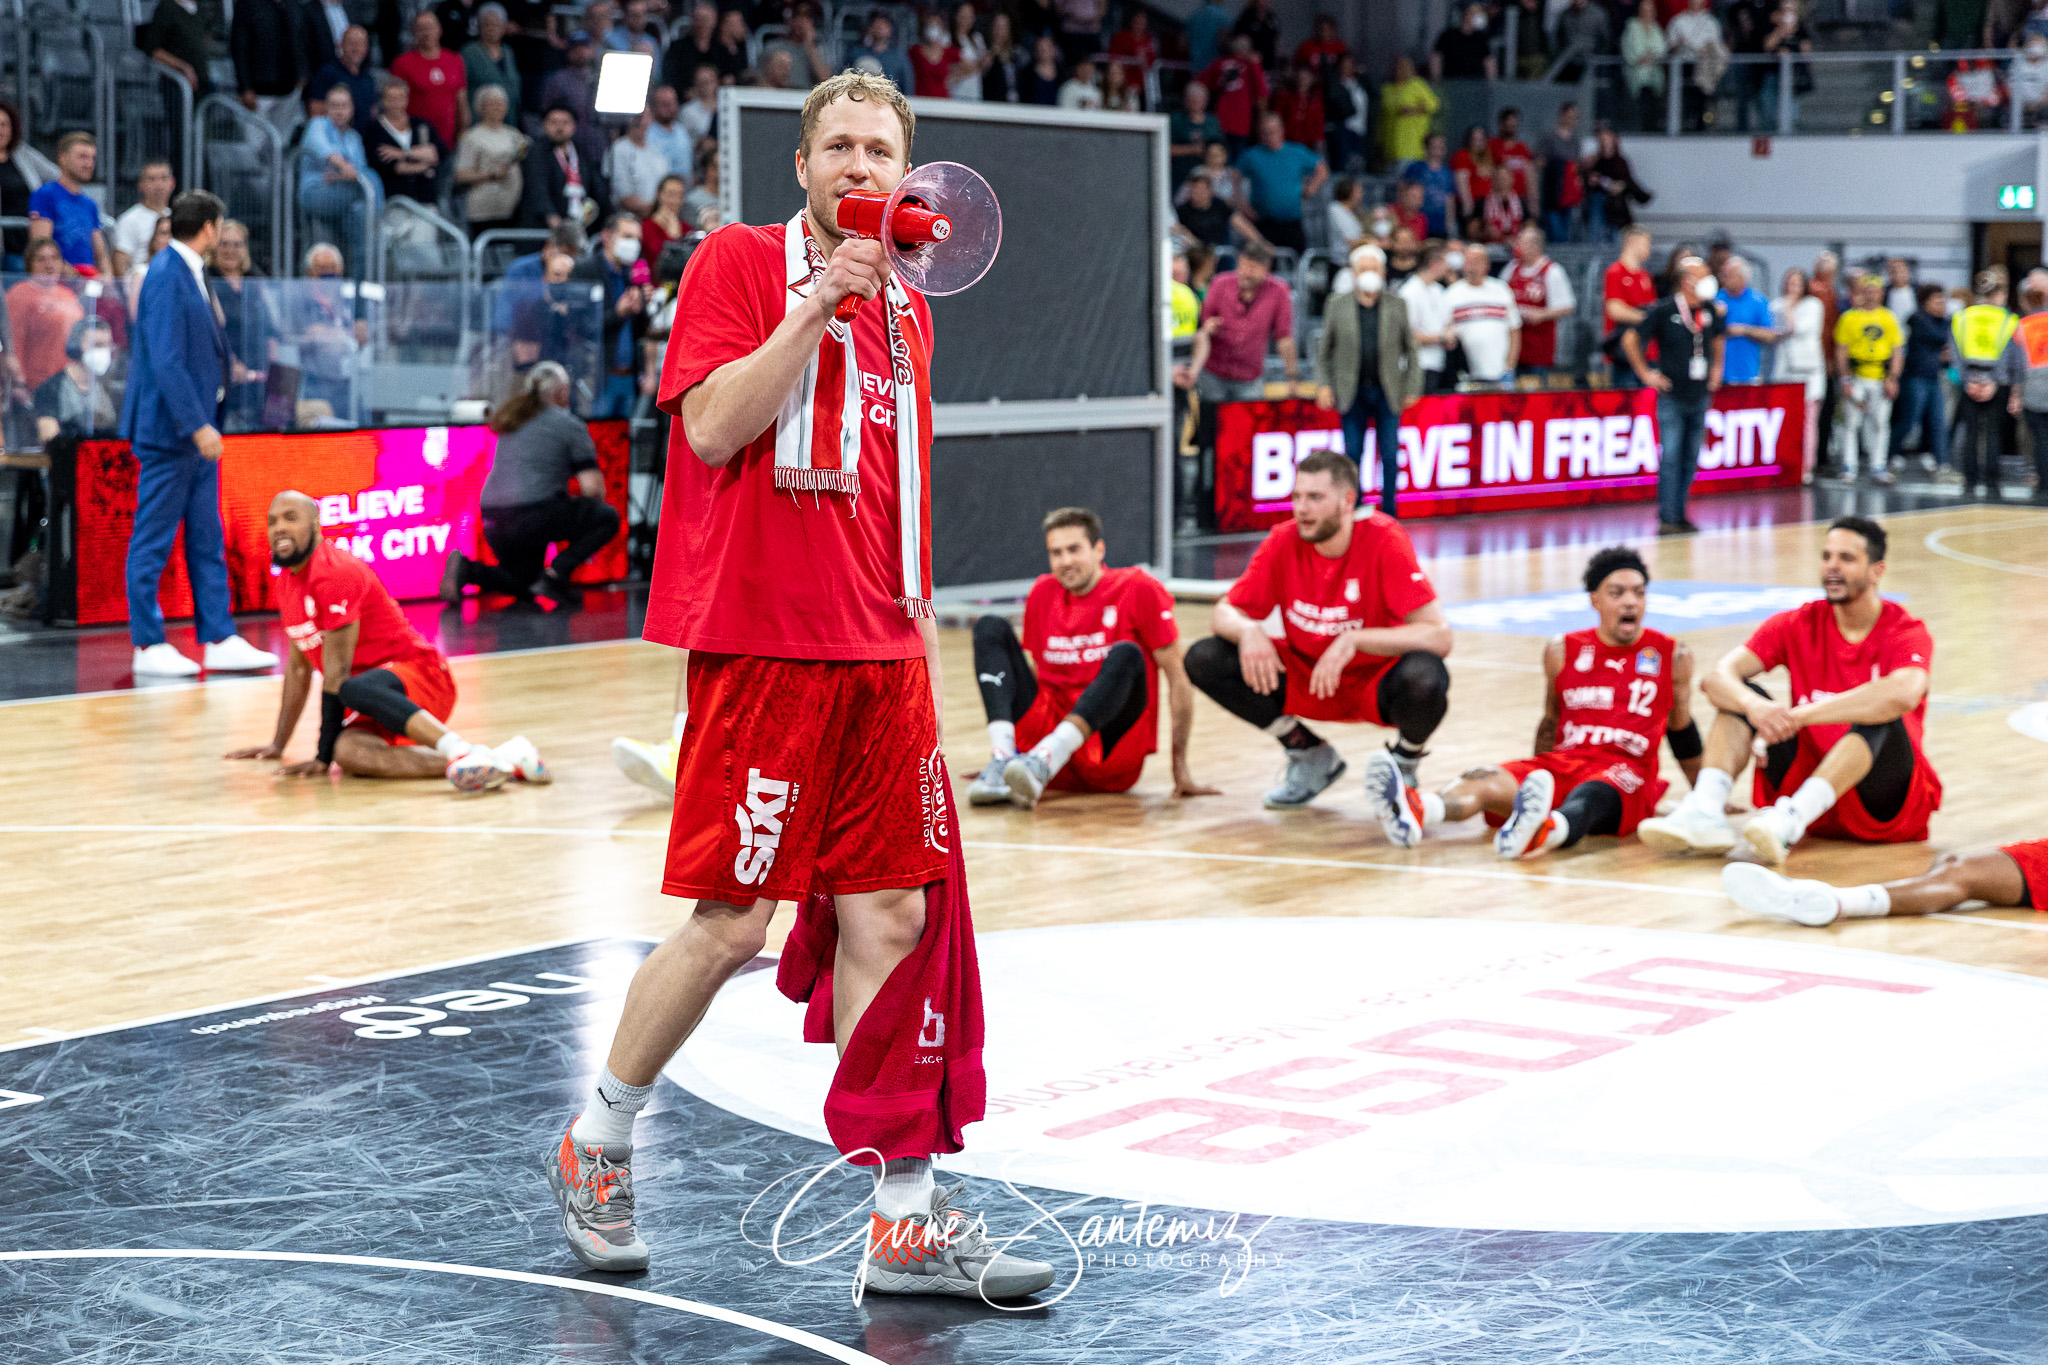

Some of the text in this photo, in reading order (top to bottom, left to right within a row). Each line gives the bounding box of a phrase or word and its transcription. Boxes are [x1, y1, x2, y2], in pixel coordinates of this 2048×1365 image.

[1480, 420, 1534, 485] IN
[1543, 414, 1662, 481] FREA
[1697, 407, 1786, 470] CITY
[313, 484, 425, 527] ELIEVE
[381, 522, 451, 561] CITY
[1627, 678, 1659, 718] 12
[734, 768, 790, 886] SIXT
[919, 757, 931, 848] AUTOMATION
[1042, 957, 1934, 1165] brose
